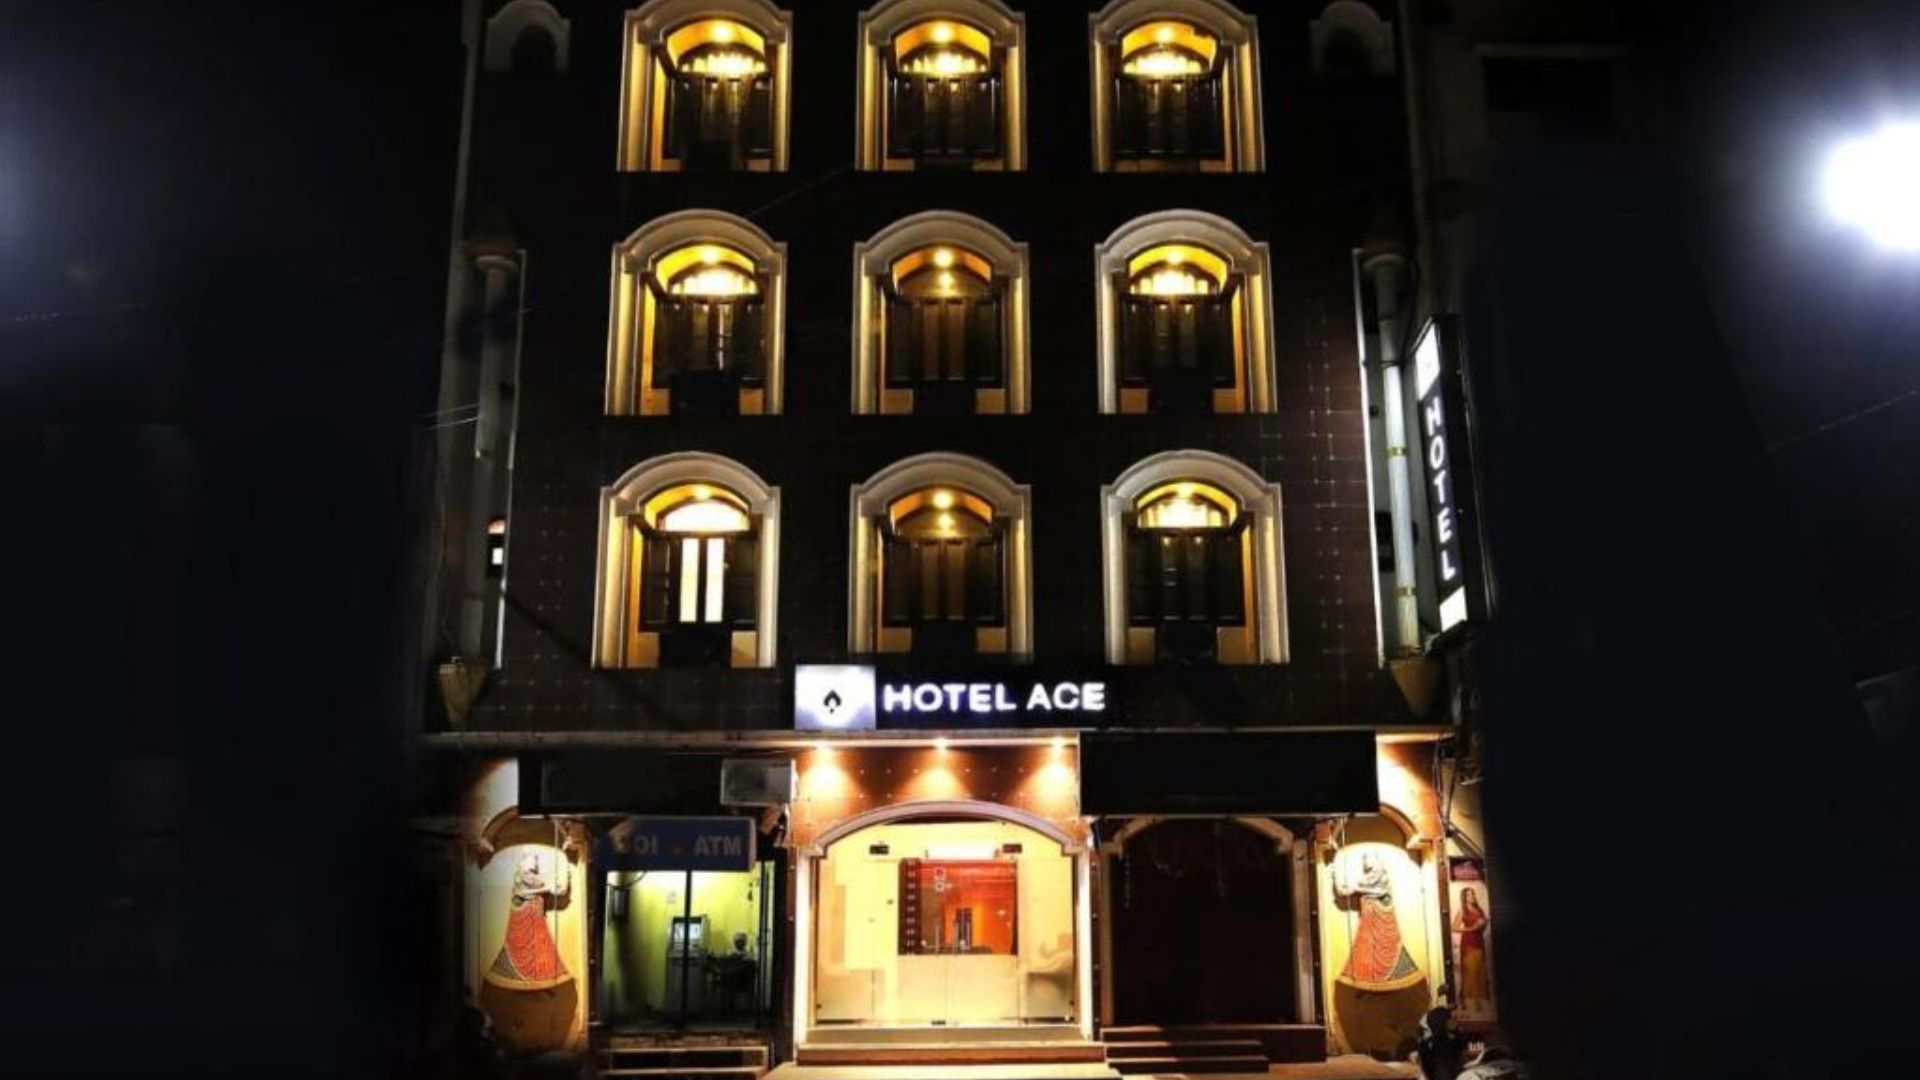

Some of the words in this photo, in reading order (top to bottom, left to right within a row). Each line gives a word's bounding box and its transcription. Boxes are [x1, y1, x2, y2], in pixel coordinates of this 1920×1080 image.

[1427, 397, 1455, 581] HOTEL
[883, 683, 1016, 712] HOTEL
[1027, 682, 1106, 711] ACE
[693, 834, 742, 857] ATM
